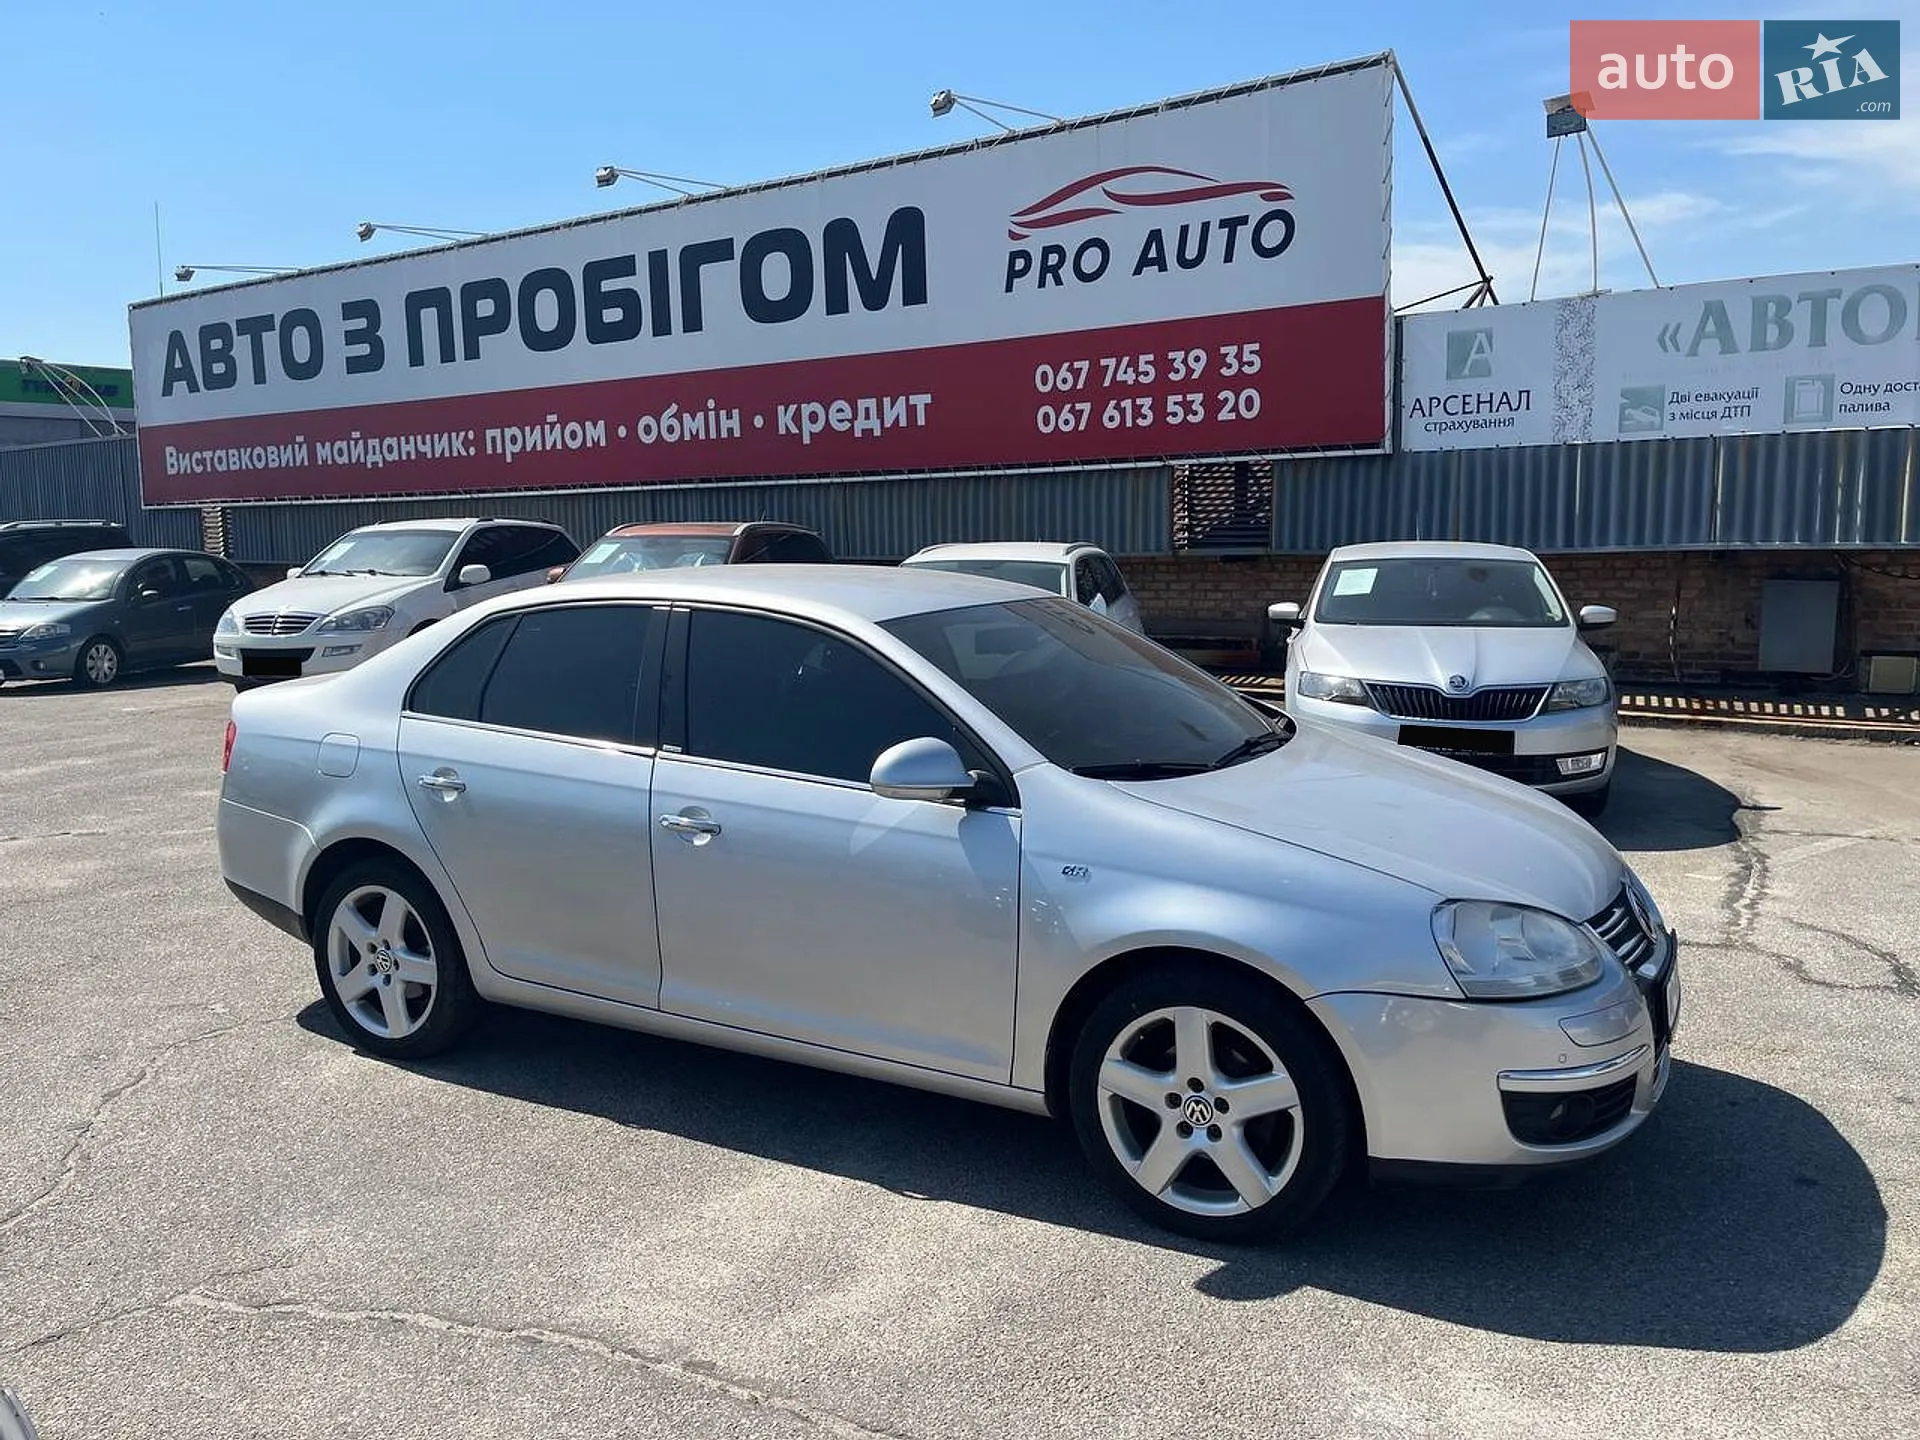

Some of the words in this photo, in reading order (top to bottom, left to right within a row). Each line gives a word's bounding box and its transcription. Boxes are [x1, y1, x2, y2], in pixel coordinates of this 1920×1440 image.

[1004, 237, 1111, 293] PRO
[1132, 208, 1296, 276] AUTO
[161, 308, 324, 397] АВТО
[341, 298, 385, 375] З
[404, 205, 928, 368] ПРОБІГОМ
[1656, 283, 1920, 357] «АВТО
[1034, 360, 1090, 393] 067
[1099, 353, 1156, 387] 745
[1167, 348, 1207, 381] 39
[1219, 343, 1262, 377] 35
[1409, 390, 1531, 418] АРСЕНАЛ
[1668, 391, 1691, 405] Дві
[1694, 387, 1760, 403] евакуації
[1839, 401, 1890, 413] палива
[1840, 382, 1880, 396] Одну
[1883, 382, 1920, 395] дост
[1036, 402, 1092, 434] 067
[1102, 397, 1154, 429] 613
[1166, 392, 1205, 425] 53
[1217, 388, 1262, 421] 20
[1424, 417, 1515, 435] страхування
[1668, 412, 1676, 421] з
[1679, 409, 1718, 421] місця
[1720, 405, 1751, 420] ДТП
[164, 435, 309, 475] Виставковий
[316, 429, 476, 469] майданчик:
[485, 413, 607, 463] прийом
[636, 398, 741, 444] обмін
[776, 393, 932, 444] кредит
